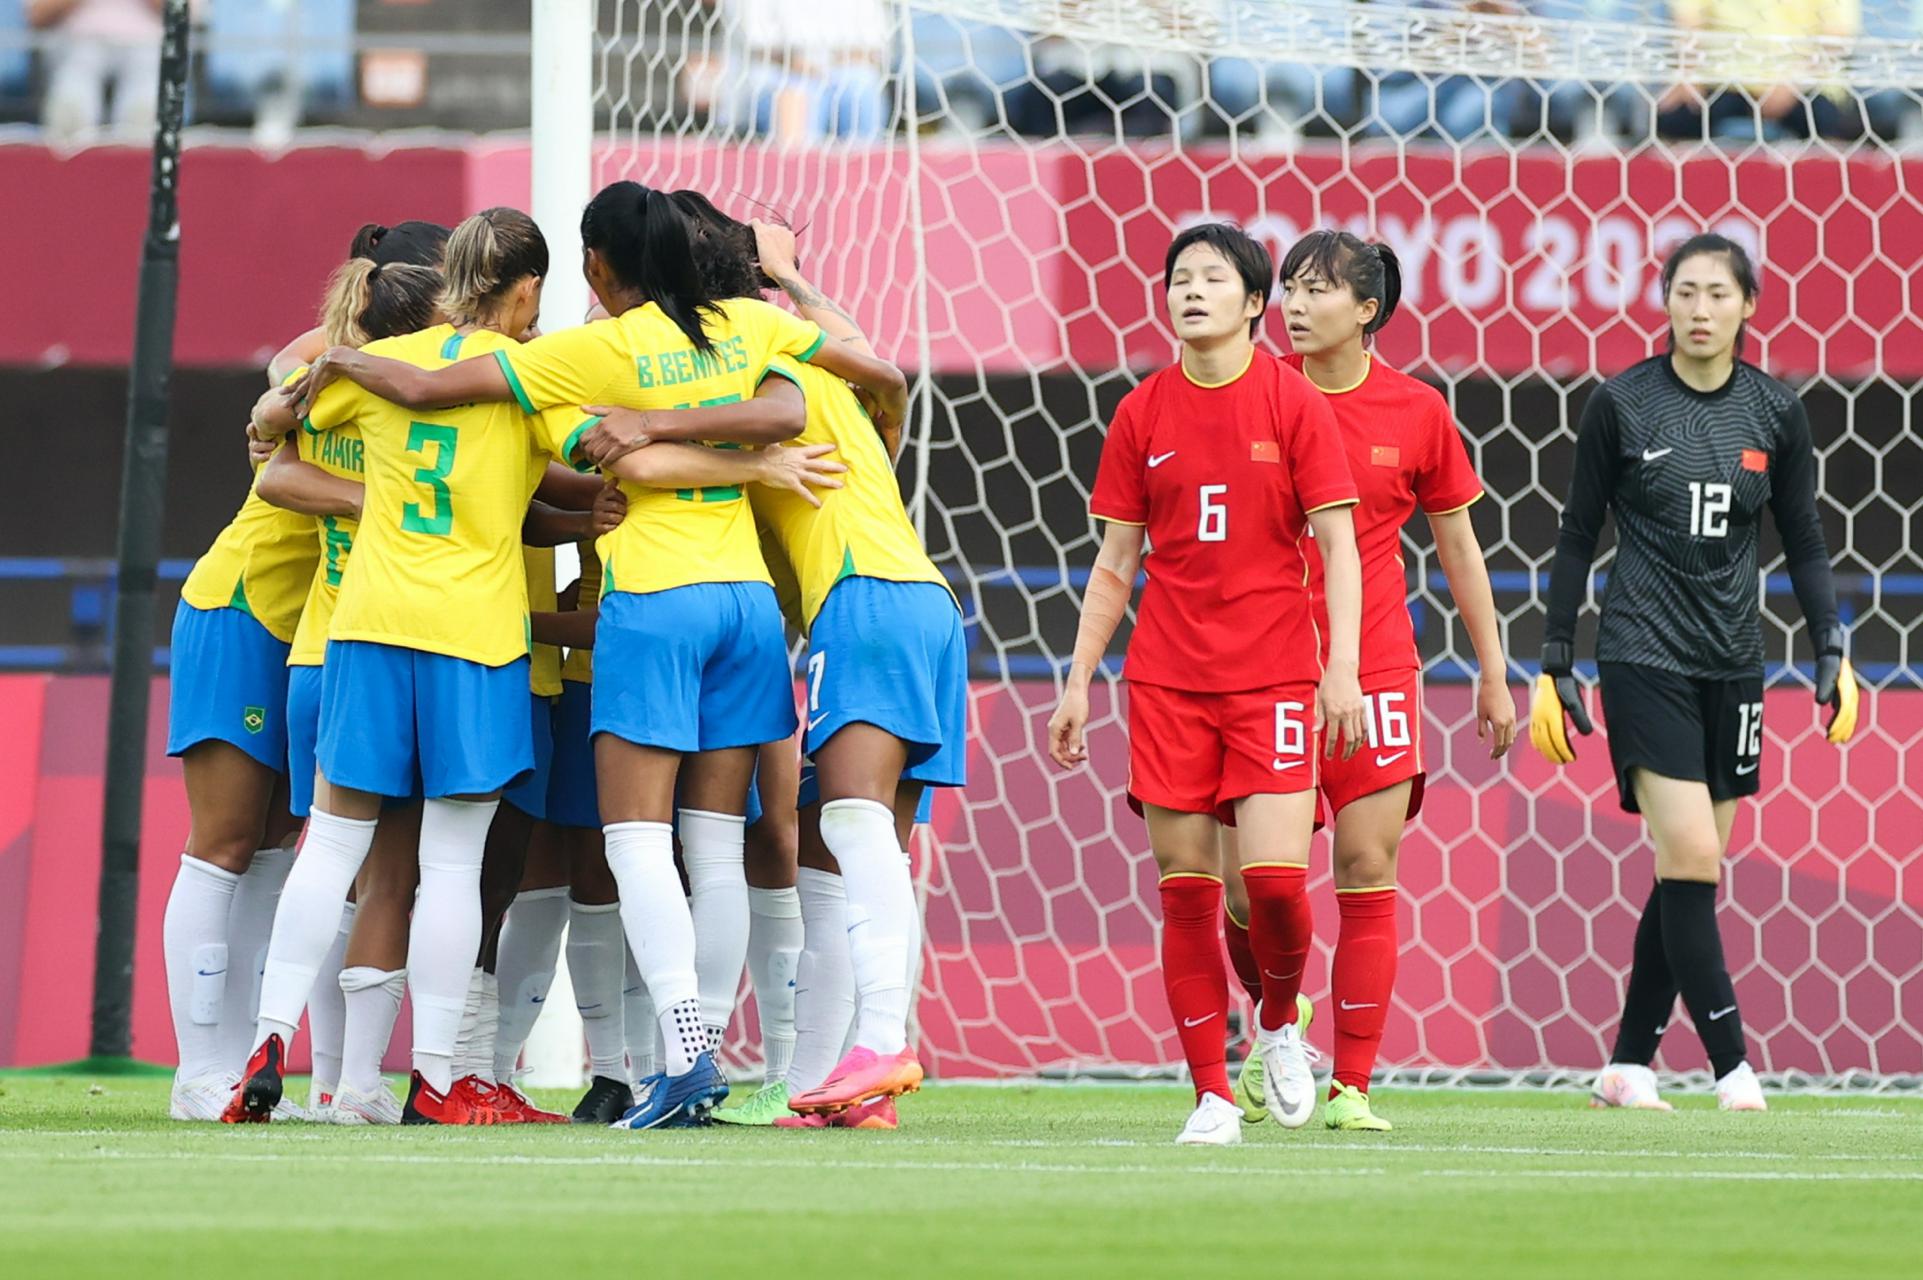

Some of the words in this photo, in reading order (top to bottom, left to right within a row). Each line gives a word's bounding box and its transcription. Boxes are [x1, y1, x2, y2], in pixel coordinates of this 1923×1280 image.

[1174, 209, 1503, 310] OYO
[400, 420, 458, 536] 3
[1198, 484, 1227, 542] 6
[1688, 481, 1732, 538] 12
[808, 650, 825, 712] 7
[1275, 701, 1305, 755] 6
[1362, 692, 1411, 749] 16
[1736, 702, 1764, 757] 12
